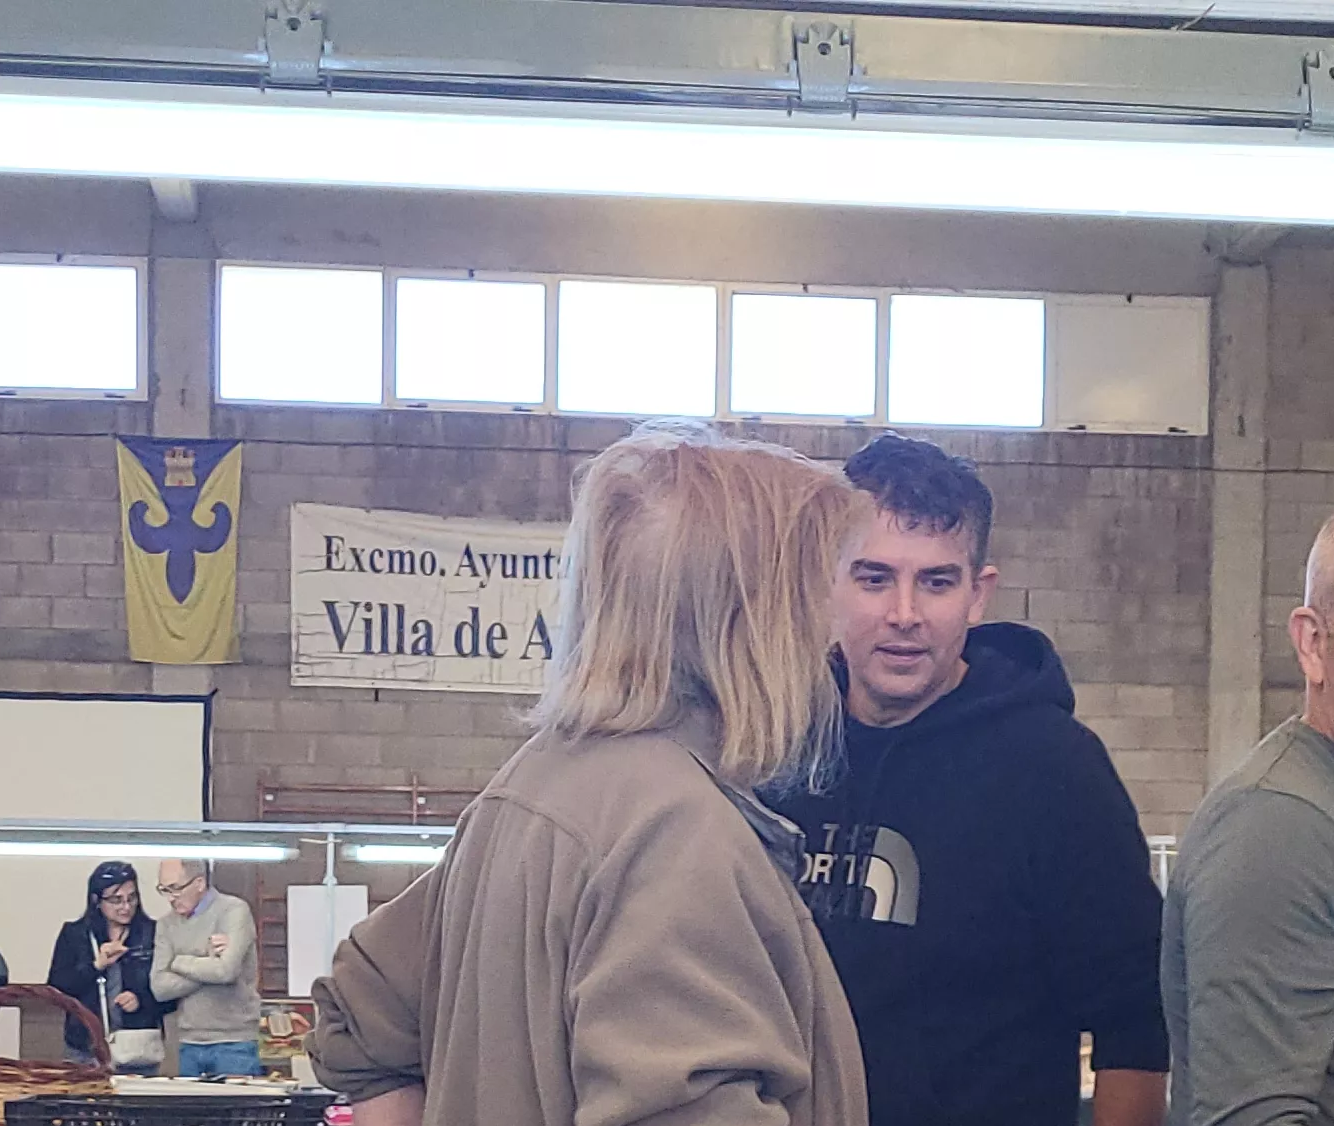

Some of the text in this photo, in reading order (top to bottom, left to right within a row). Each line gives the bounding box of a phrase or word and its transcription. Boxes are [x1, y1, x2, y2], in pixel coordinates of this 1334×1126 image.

[323, 535, 447, 578] Excmo.
[323, 600, 435, 657] Villa
[454, 606, 508, 659] de
